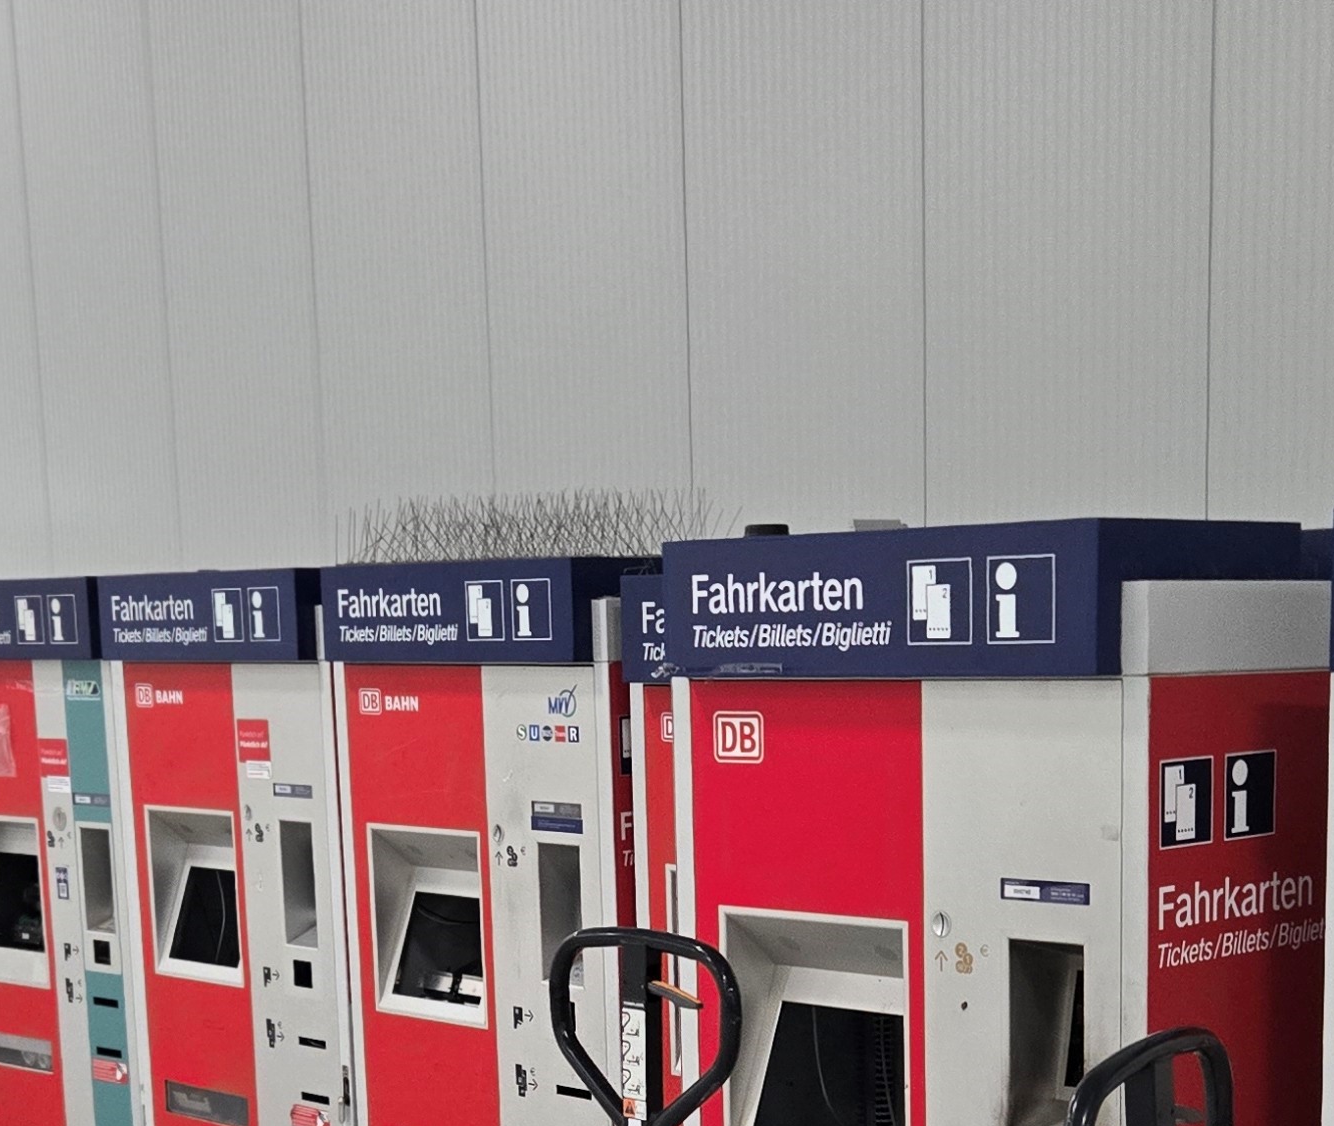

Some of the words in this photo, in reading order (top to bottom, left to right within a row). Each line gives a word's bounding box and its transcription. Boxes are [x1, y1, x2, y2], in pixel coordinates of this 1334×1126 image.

[337, 588, 442, 618] Fahrkarten
[691, 571, 864, 615] Fahrkarten
[110, 595, 194, 622] Fahrkarten
[112, 625, 208, 644] Tickets/Billets/Biglietti
[339, 622, 459, 646] Tickets/Billets/Biglietti
[692, 620, 893, 652] Tickets/Billets/Biglietti
[136, 685, 152, 706] DB
[155, 690, 183, 705] BAHN
[361, 690, 380, 712] DB
[385, 696, 419, 712] BAHN
[717, 716, 761, 757] DB
[1158, 871, 1313, 931] Fahrkarten
